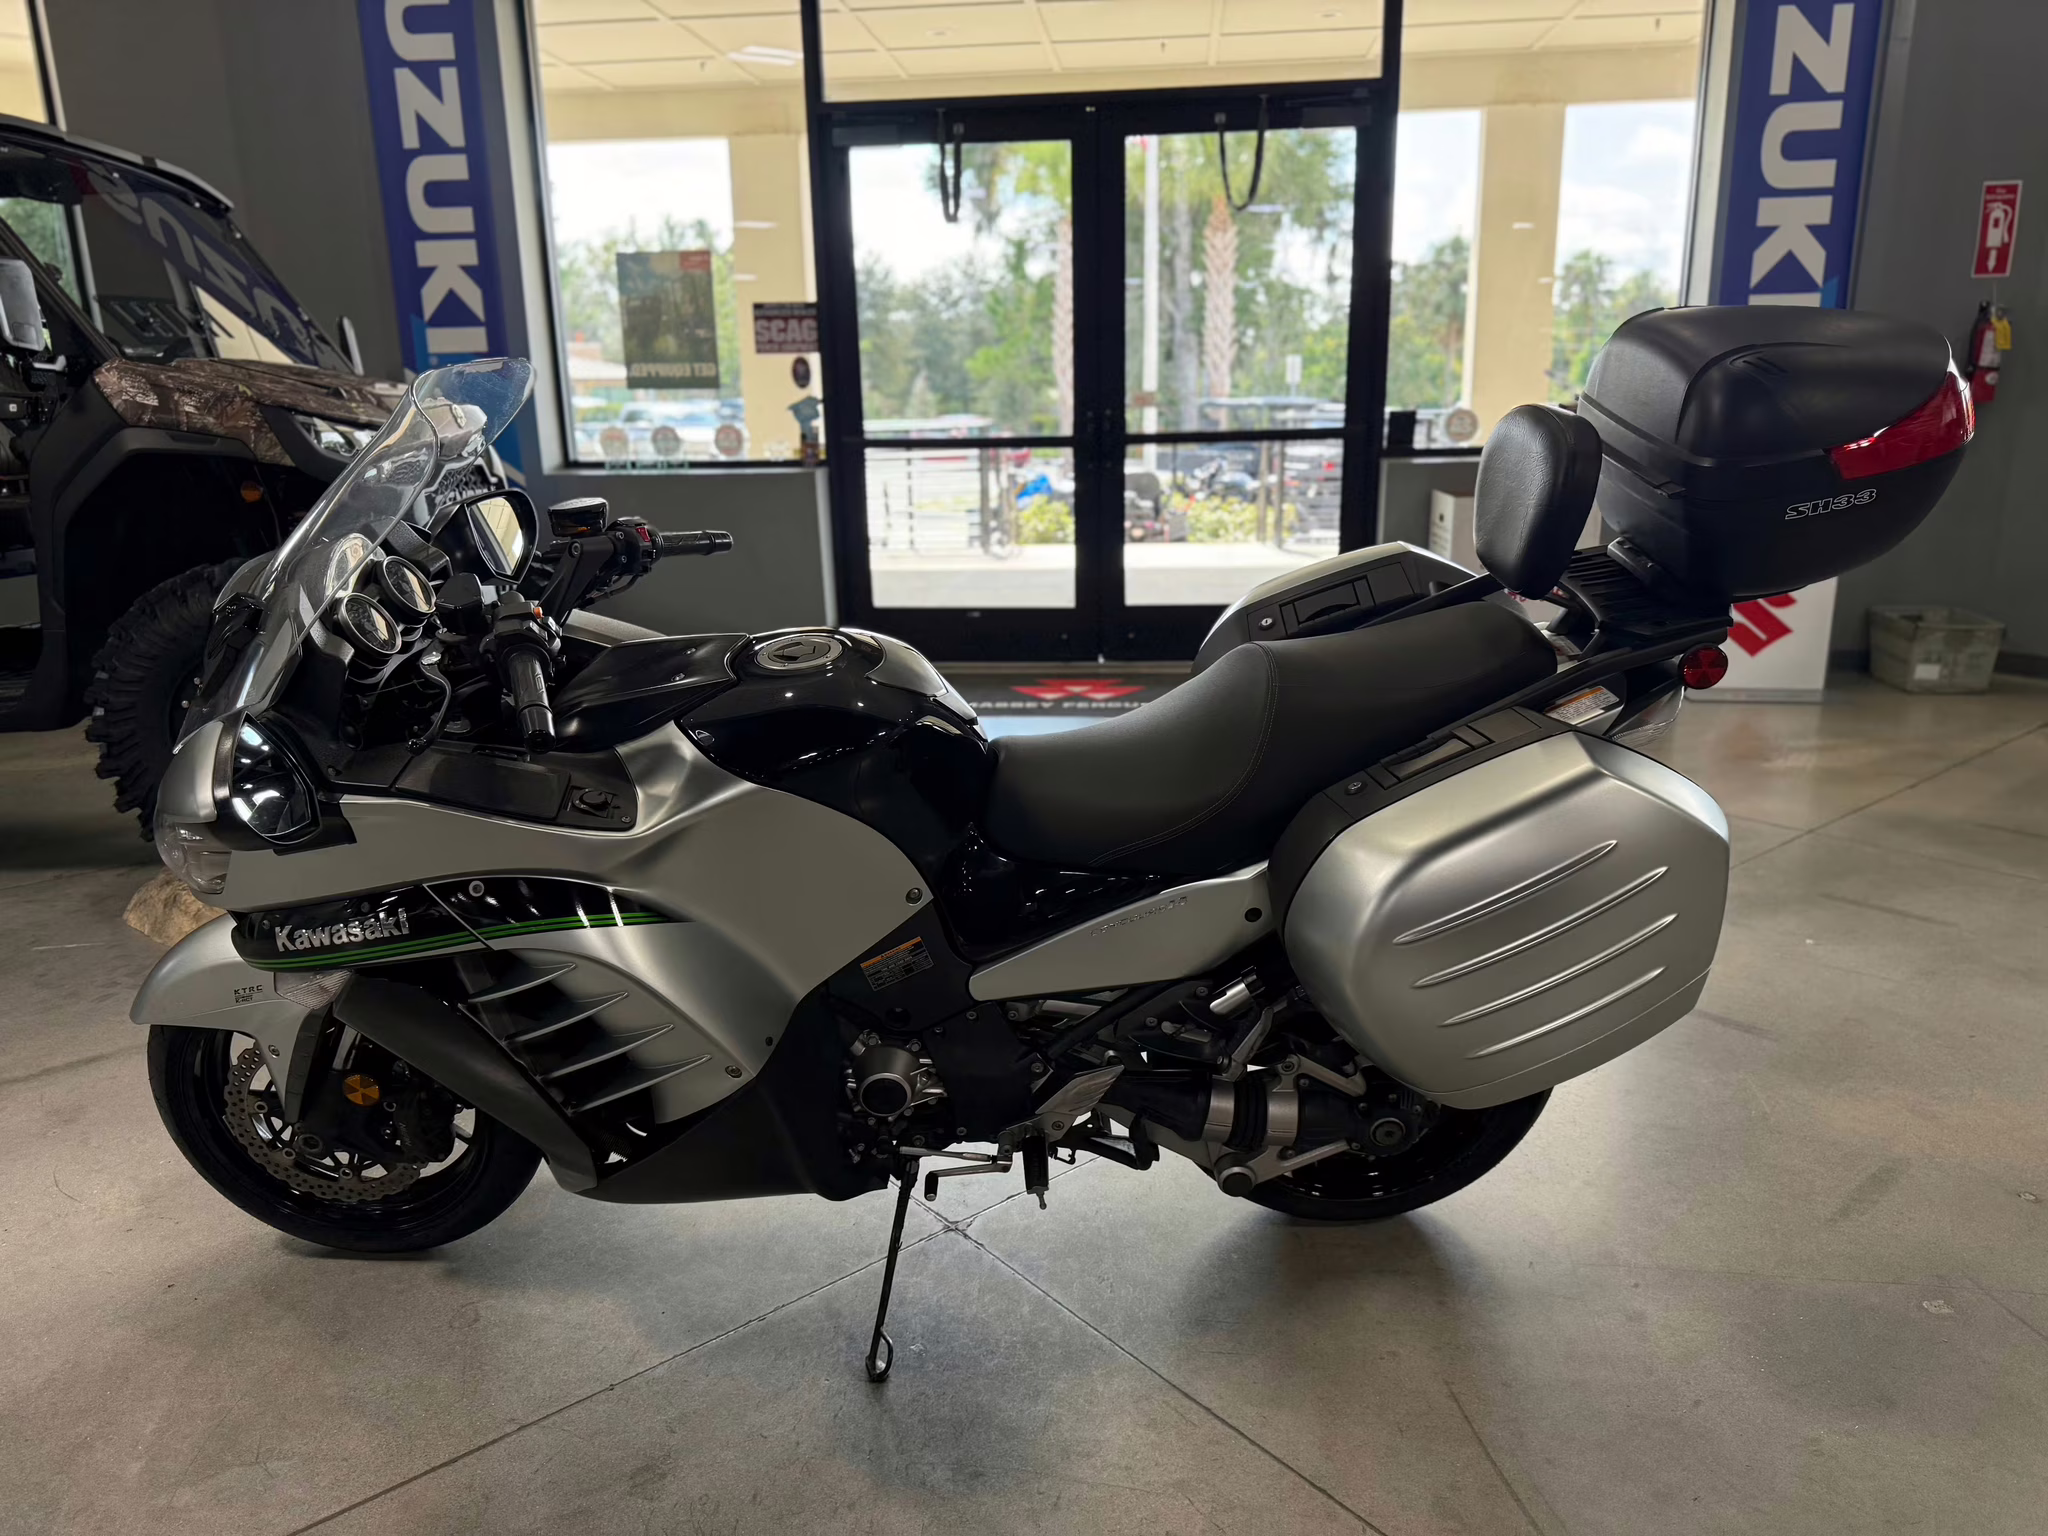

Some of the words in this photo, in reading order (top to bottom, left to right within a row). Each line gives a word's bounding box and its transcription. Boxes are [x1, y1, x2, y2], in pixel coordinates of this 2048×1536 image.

[384, 0, 489, 354] UZUKI
[756, 318, 818, 343] SCAG
[1784, 488, 1877, 520] SH33
[274, 907, 410, 952] Kawasaki
[233, 984, 263, 995] KTRC
